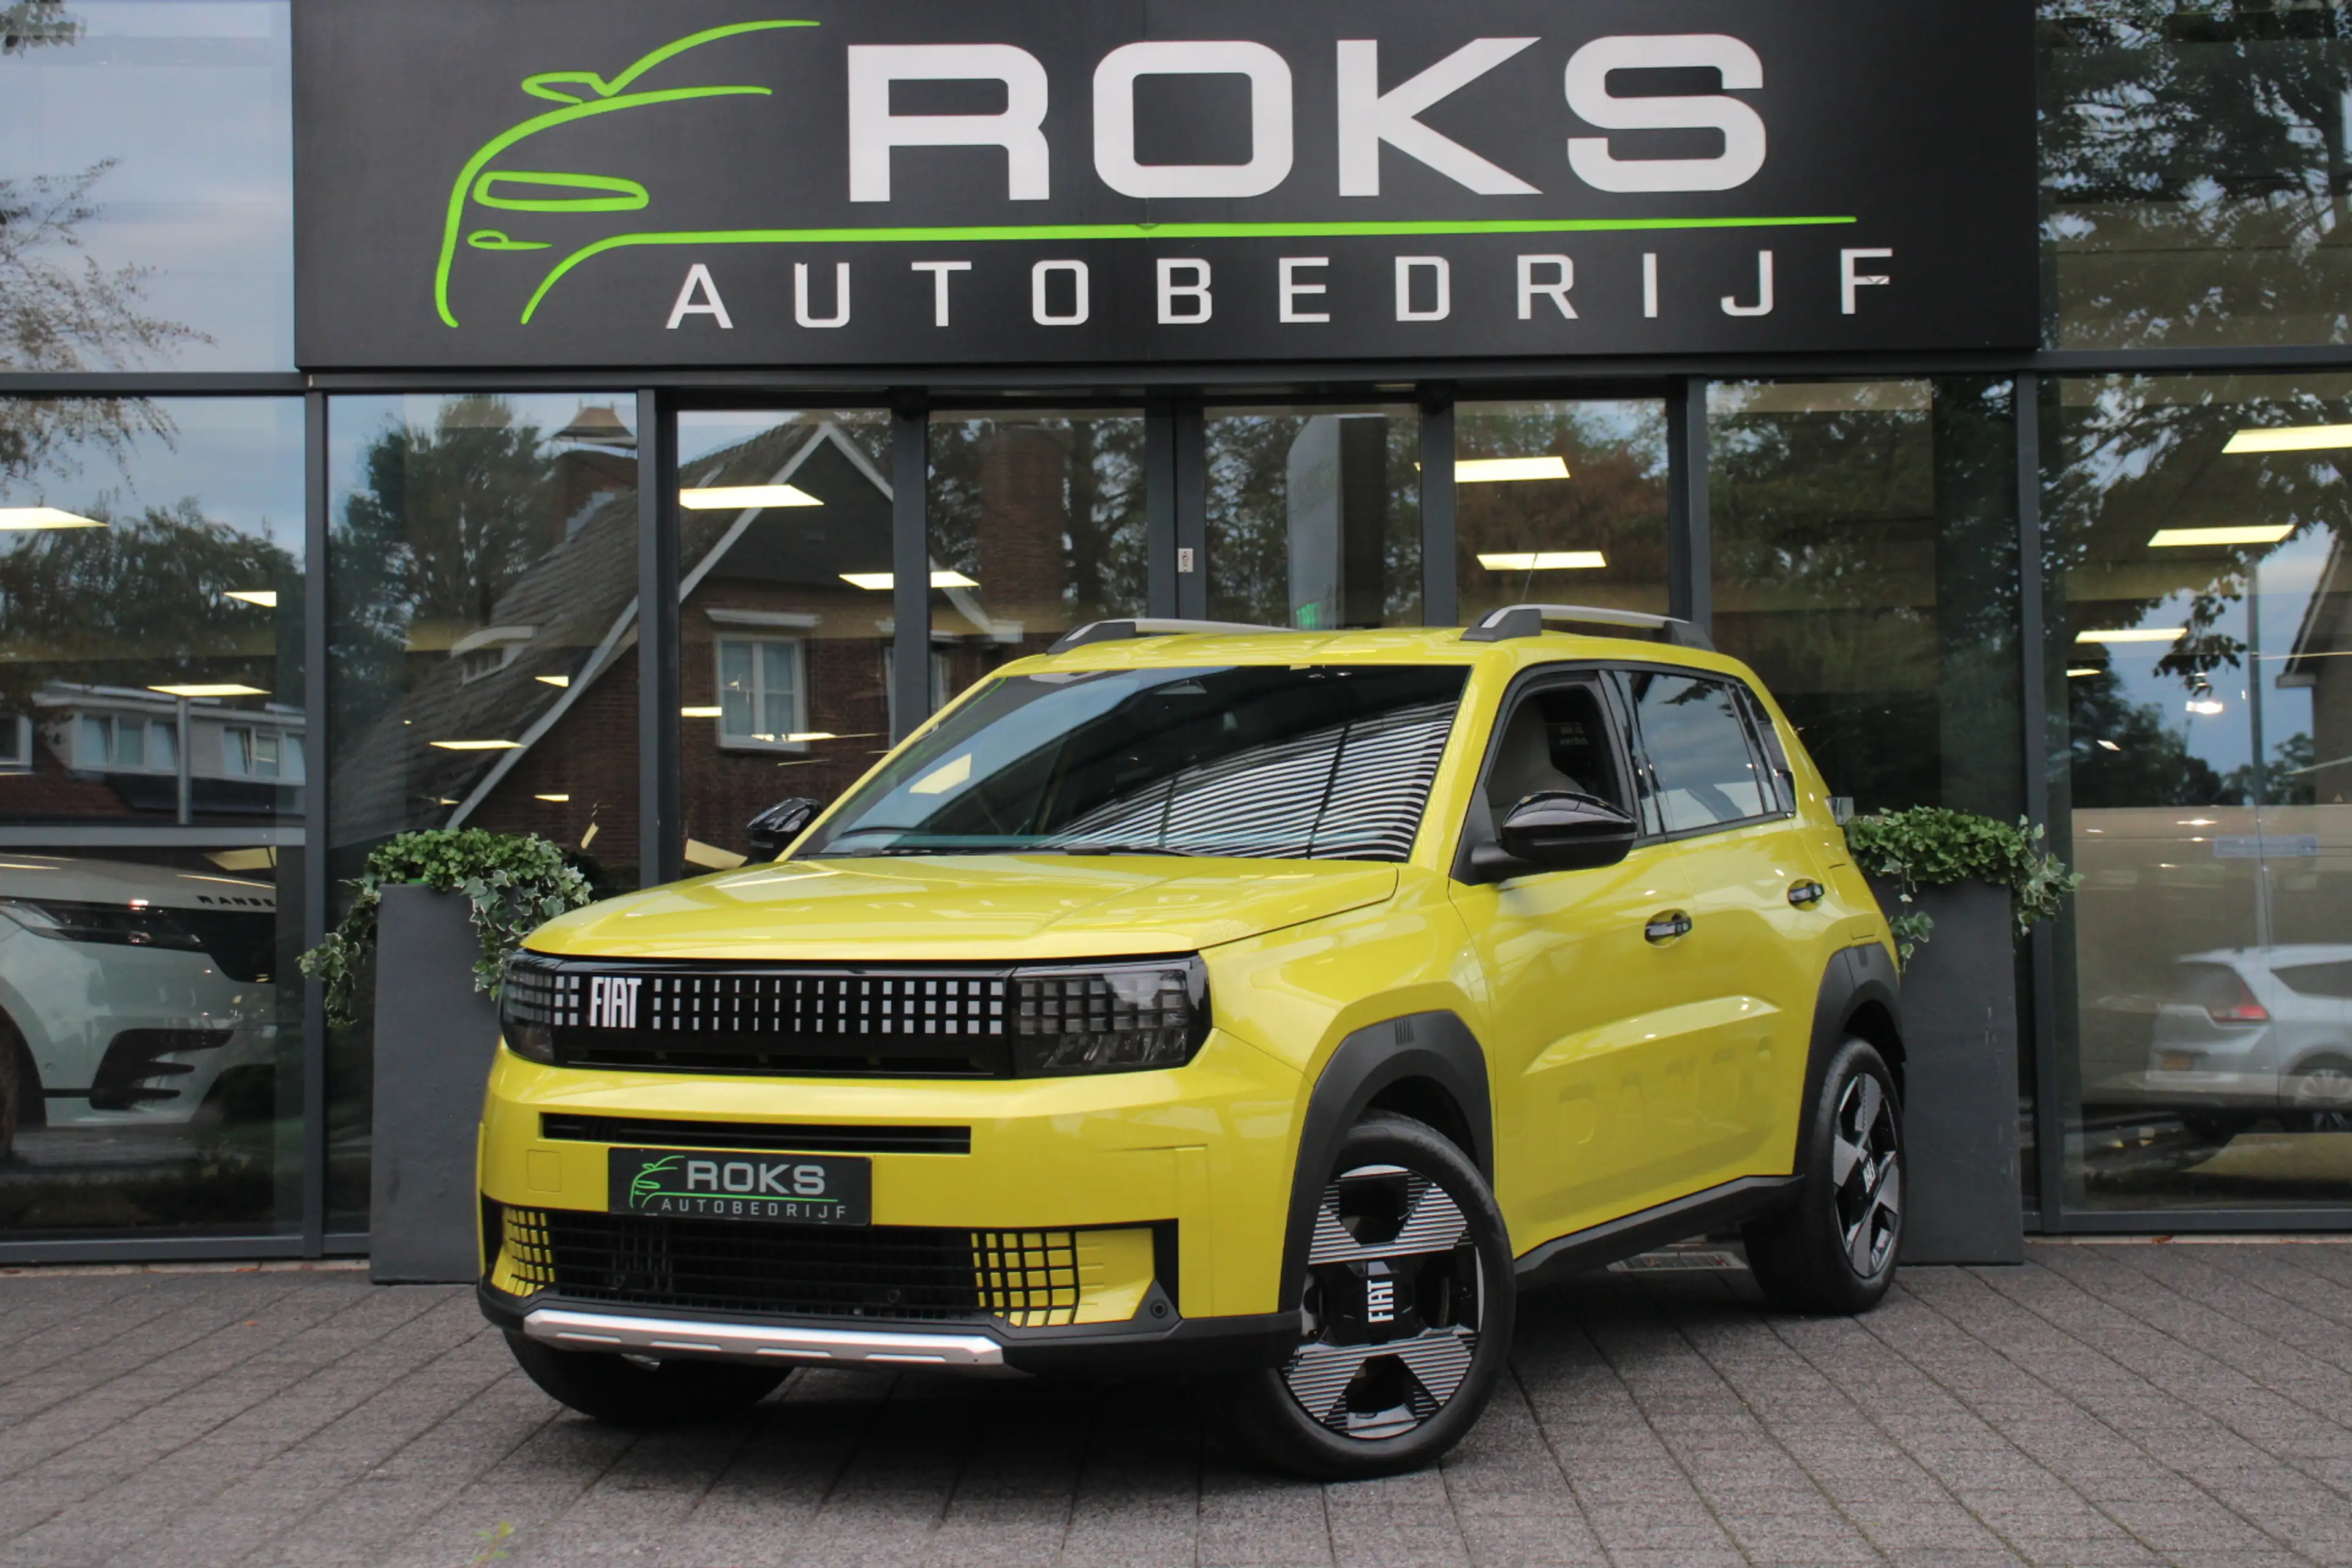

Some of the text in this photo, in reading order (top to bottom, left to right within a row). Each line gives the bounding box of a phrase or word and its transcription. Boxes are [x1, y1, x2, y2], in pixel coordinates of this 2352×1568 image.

[848, 34, 1766, 202] ROKS
[666, 249, 1893, 330] AUTOBEDRIJF
[590, 976, 642, 1028] FIAT
[687, 1160, 826, 1195] ROKS
[661, 1198, 846, 1219] AUTOBEDRIJF
[1367, 1280, 1394, 1322] FIAT
